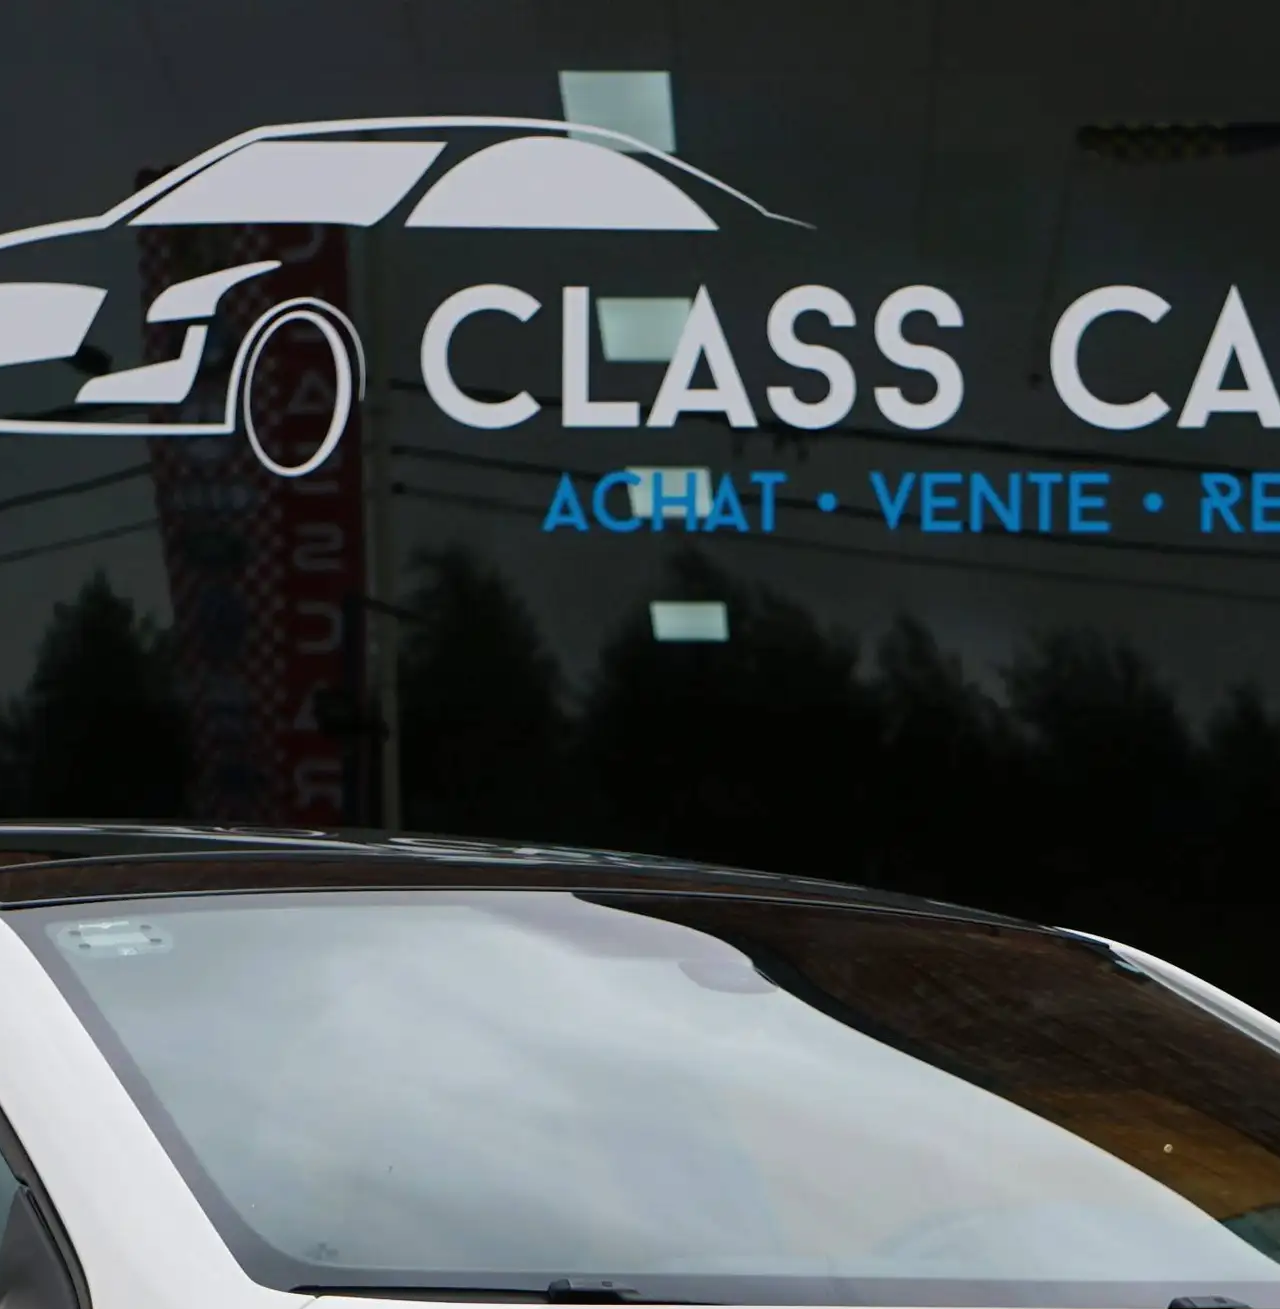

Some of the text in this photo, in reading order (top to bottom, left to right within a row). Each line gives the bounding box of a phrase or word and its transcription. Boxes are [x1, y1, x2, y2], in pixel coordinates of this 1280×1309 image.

[420, 284, 963, 429] CLASS
[542, 471, 786, 533] ACHAT
[871, 471, 1110, 533] VENTE
